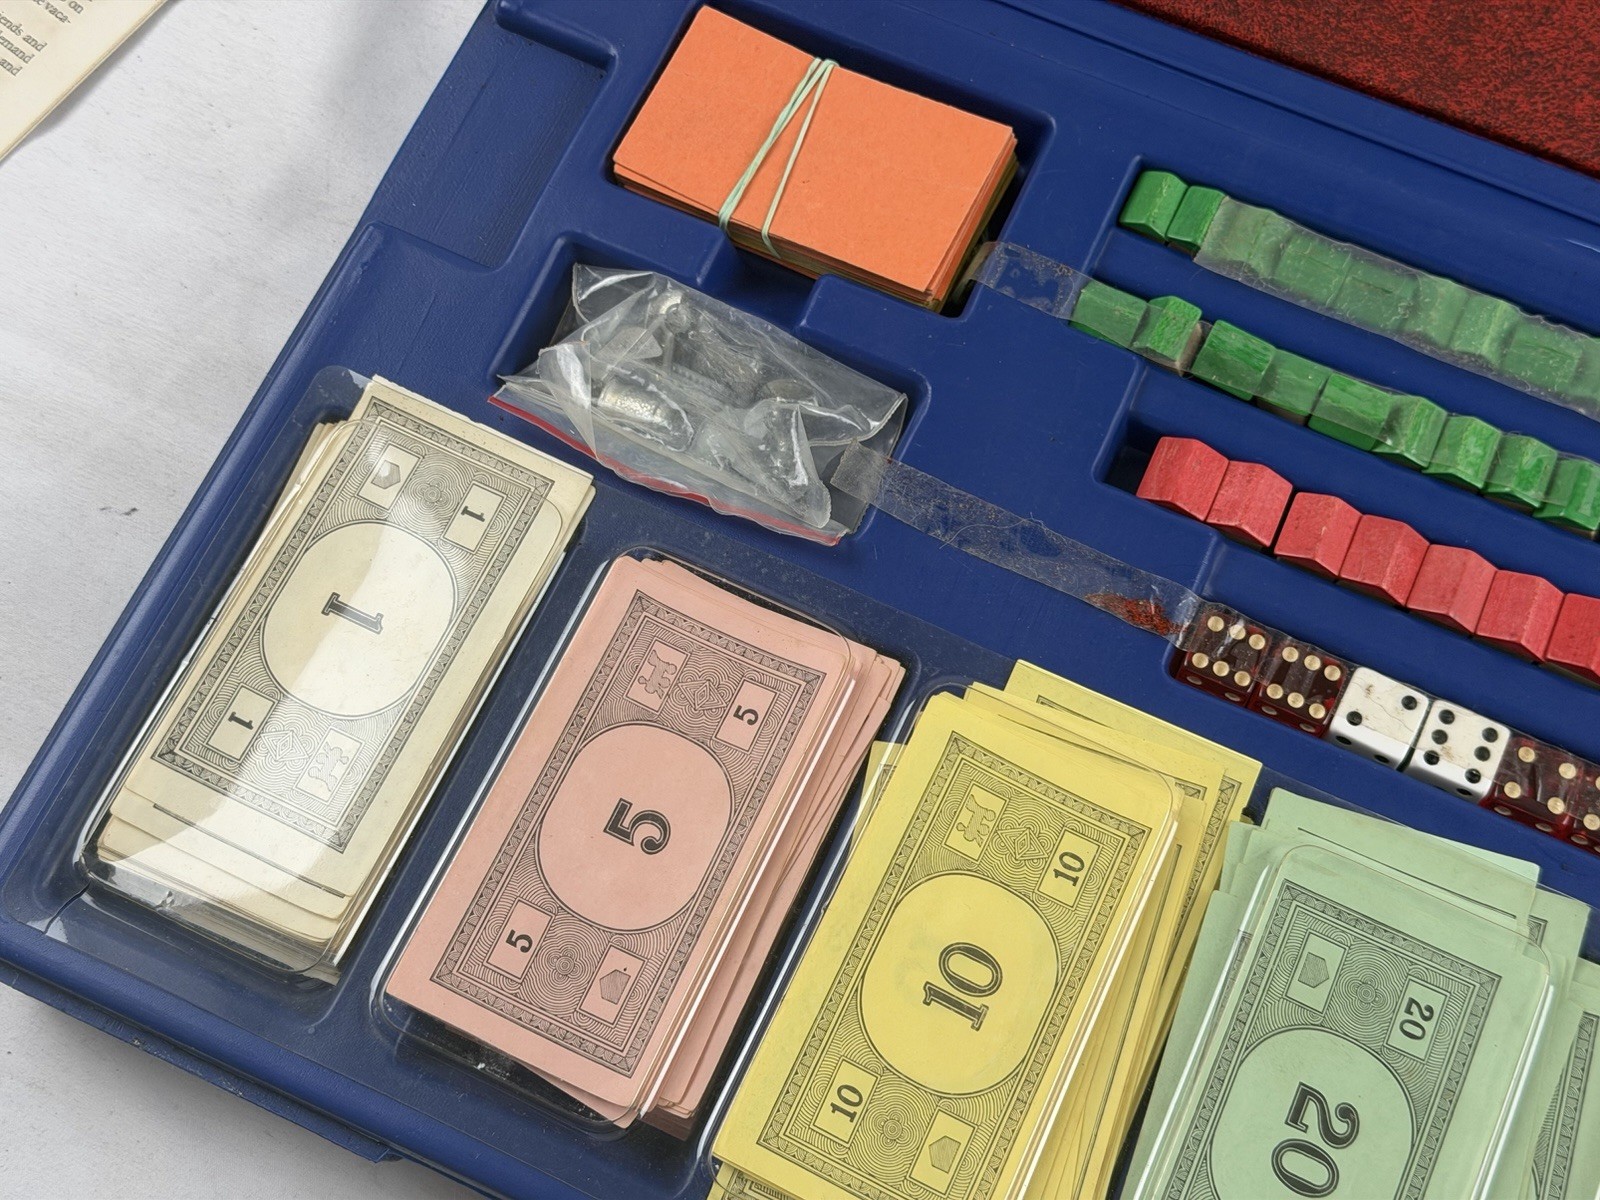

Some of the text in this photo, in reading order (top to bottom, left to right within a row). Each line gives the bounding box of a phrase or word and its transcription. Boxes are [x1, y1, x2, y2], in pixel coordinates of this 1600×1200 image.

[68, 0, 84, 14] on
[0, 11, 48, 52] ends and
[0, 30, 35, 64] emand
[0, 58, 23, 76] and
[460, 505, 486, 523] 1
[321, 591, 384, 635] 1
[227, 711, 254, 731] 1
[732, 704, 759, 726] 5
[602, 797, 672, 856] 5
[1052, 851, 1085, 887] 10
[505, 929, 533, 954] 5
[922, 941, 1004, 1032] 10
[1399, 996, 1435, 1041] 20
[829, 1084, 864, 1123] 10
[1271, 1081, 1361, 1199] 20
